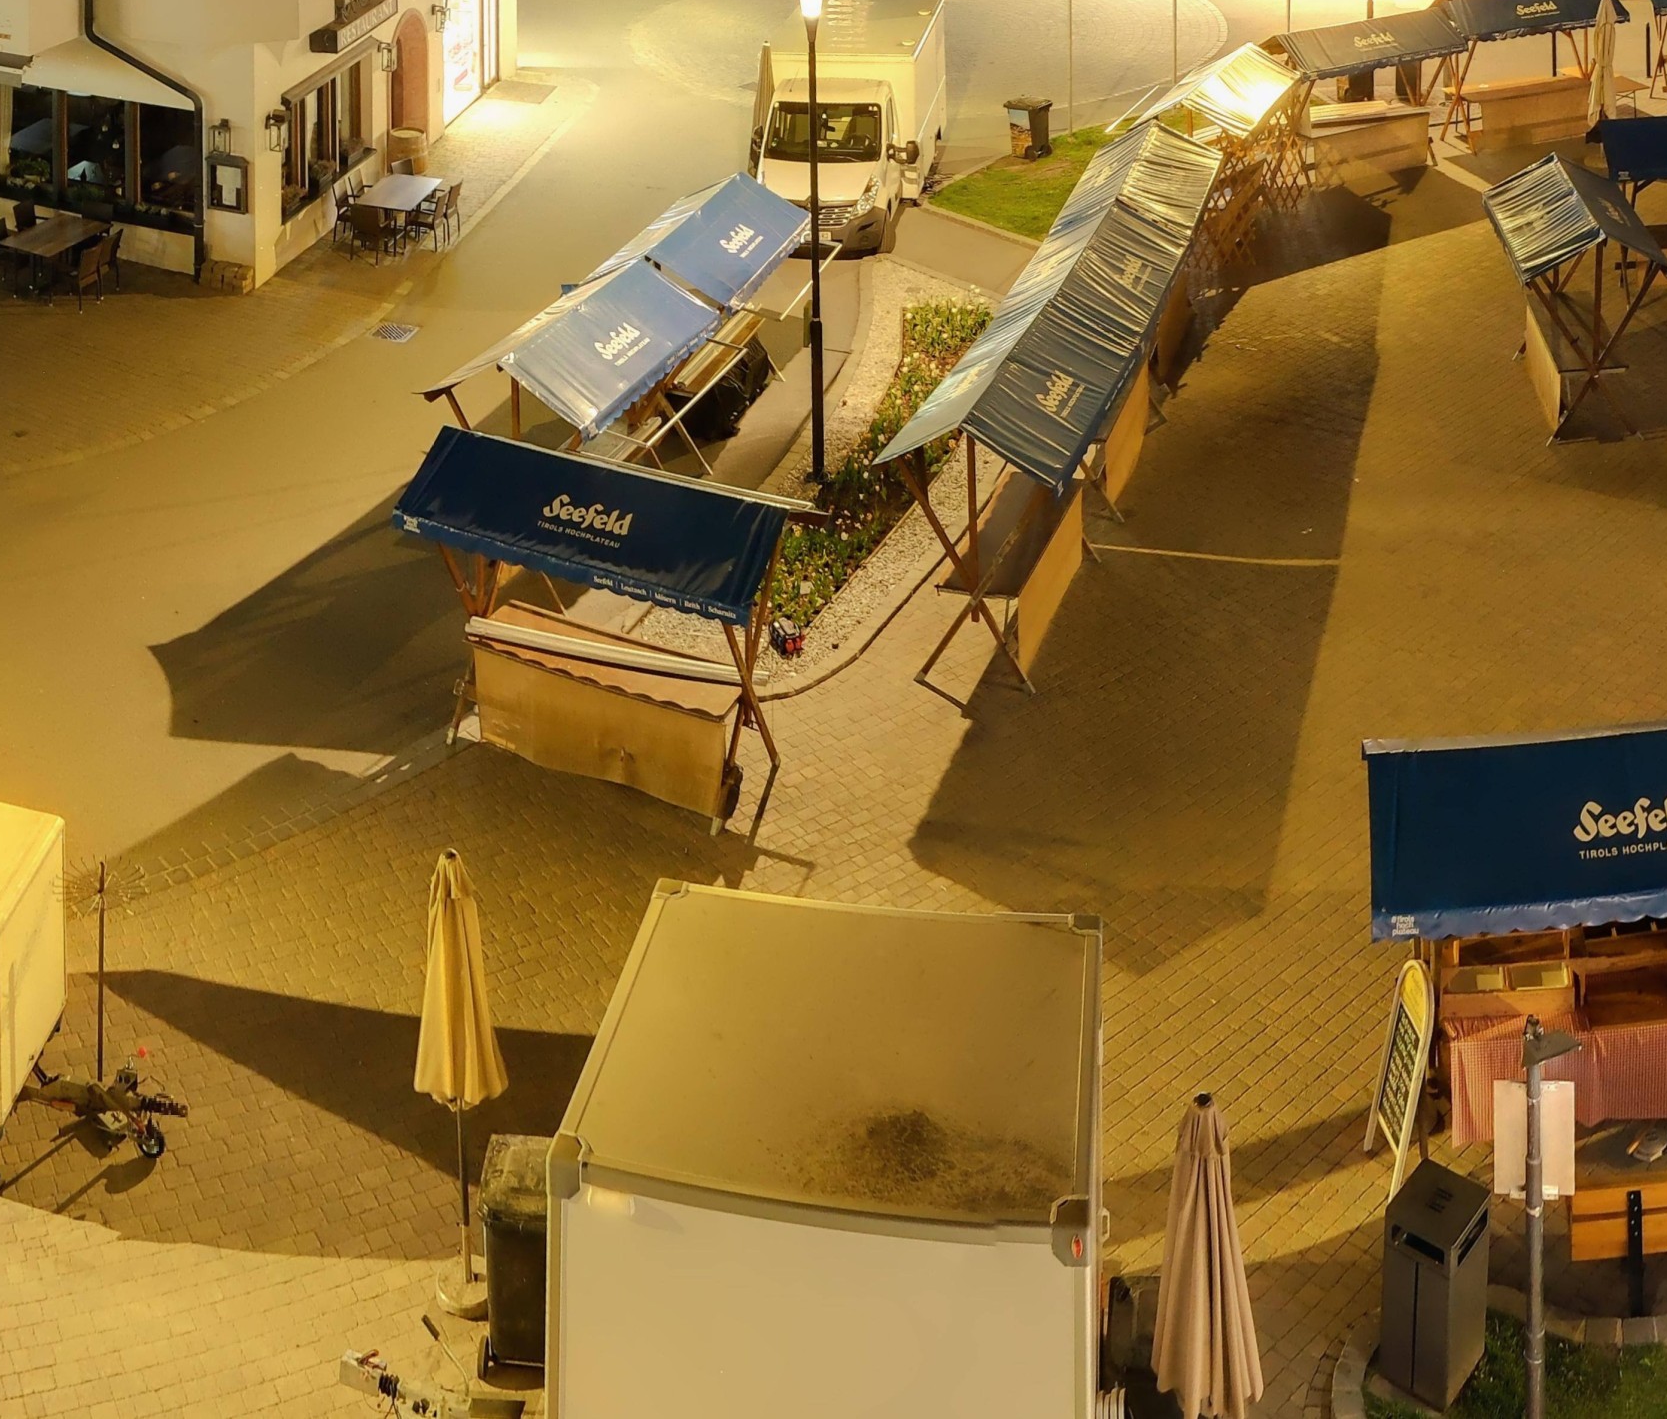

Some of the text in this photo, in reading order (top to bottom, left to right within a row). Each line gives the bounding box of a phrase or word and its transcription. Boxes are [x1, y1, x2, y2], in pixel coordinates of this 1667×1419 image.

[1516, 0, 1558, 16] Seefeld
[542, 493, 634, 537] Seefeld
[537, 519, 622, 550] TIROLS HOCHPLATEAU
[1578, 847, 1618, 860] TIROLS
